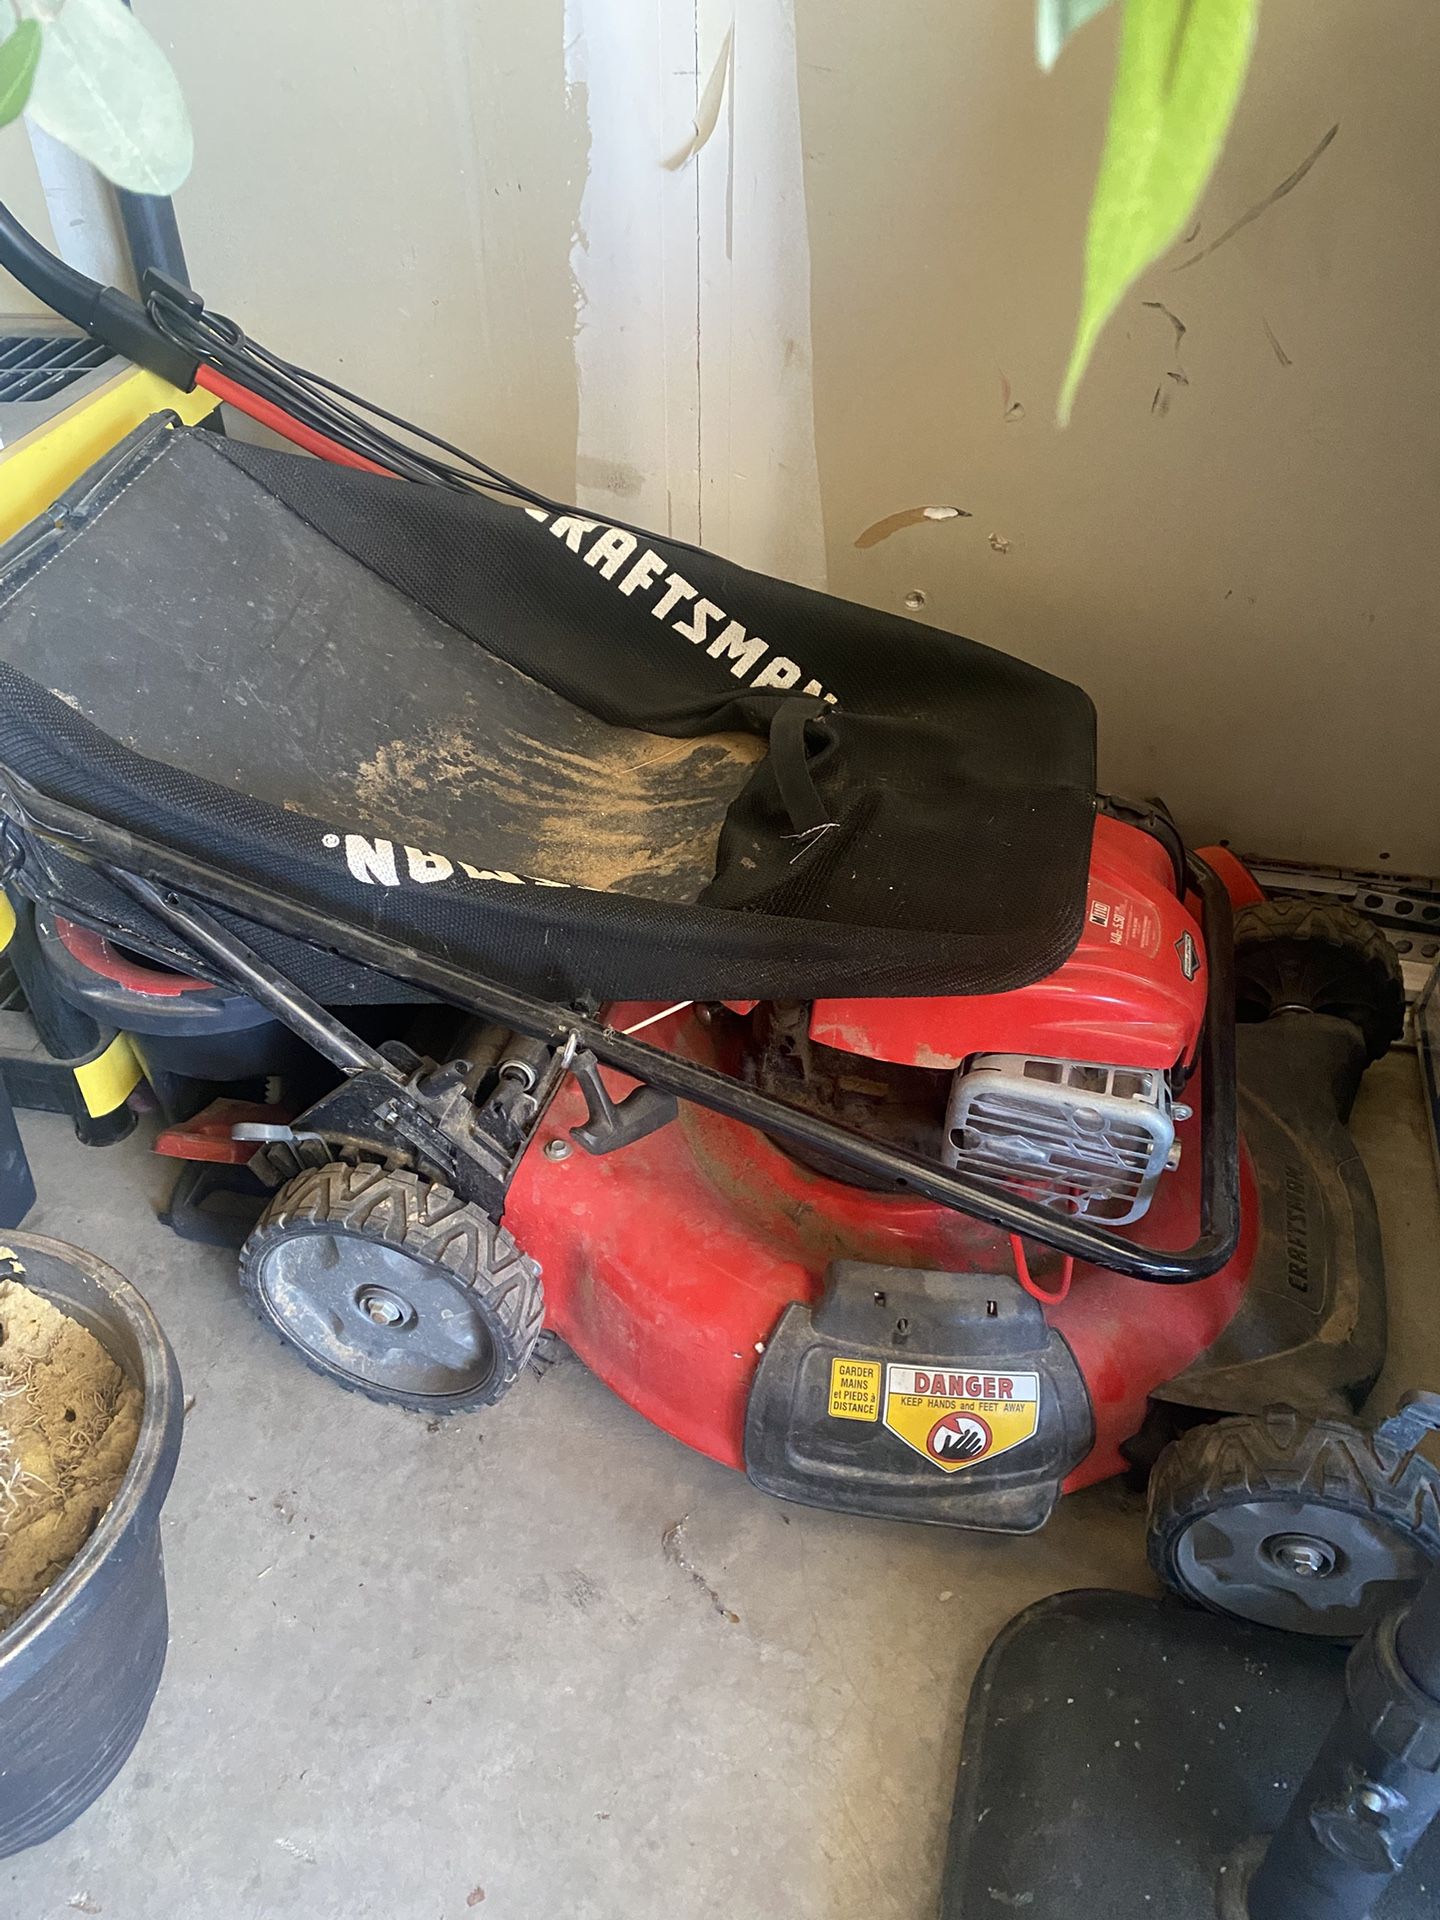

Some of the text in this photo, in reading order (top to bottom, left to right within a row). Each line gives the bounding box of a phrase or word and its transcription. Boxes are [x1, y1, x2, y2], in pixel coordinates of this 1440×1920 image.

[1285, 1165, 1308, 1293] CRAFTSMAN
[839, 1365, 874, 1378] GARDER
[840, 1377, 869, 1390] MAINS
[914, 1371, 1014, 1399] DANGER
[833, 1390, 842, 1400] et
[843, 1390, 869, 1403] PIEDS
[833, 1400, 875, 1414] DISTANCE
[901, 1396, 1026, 1413] KEEP HANDS and FEET AWAY
